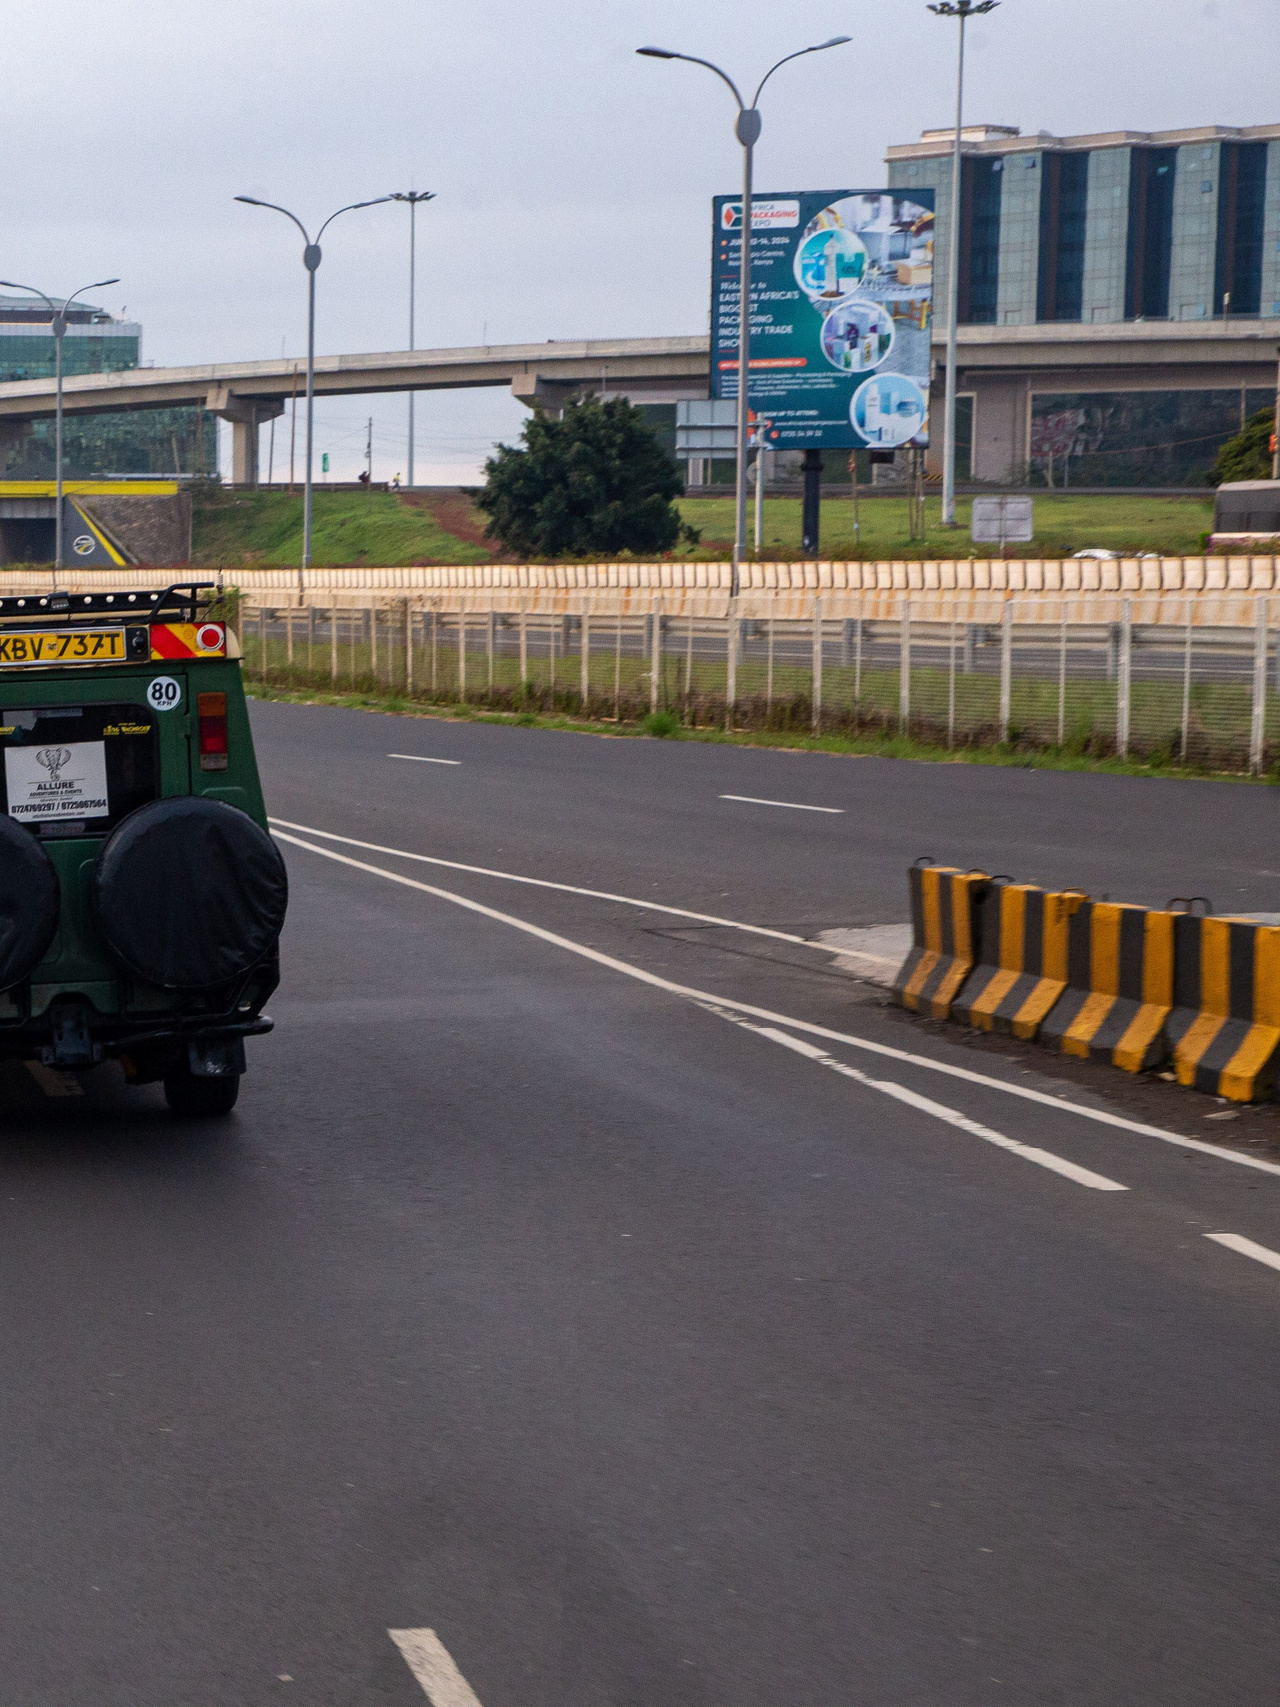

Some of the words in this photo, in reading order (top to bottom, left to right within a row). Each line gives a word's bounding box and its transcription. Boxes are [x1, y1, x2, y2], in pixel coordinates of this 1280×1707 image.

[751, 210, 797, 218] ACKAGING
[721, 281, 756, 290] Welcoe
[719, 292, 758, 302] EASTN
[719, 303, 759, 313] BIGGST
[719, 314, 774, 325] PACKGING
[718, 327, 762, 336] INDURY
[764, 325, 793, 335] TRADE
[718, 338, 741, 348] SHO
[57, 633, 120, 657] 737T
[151, 682, 177, 700] 80
[37, 781, 75, 791] ALLURE
